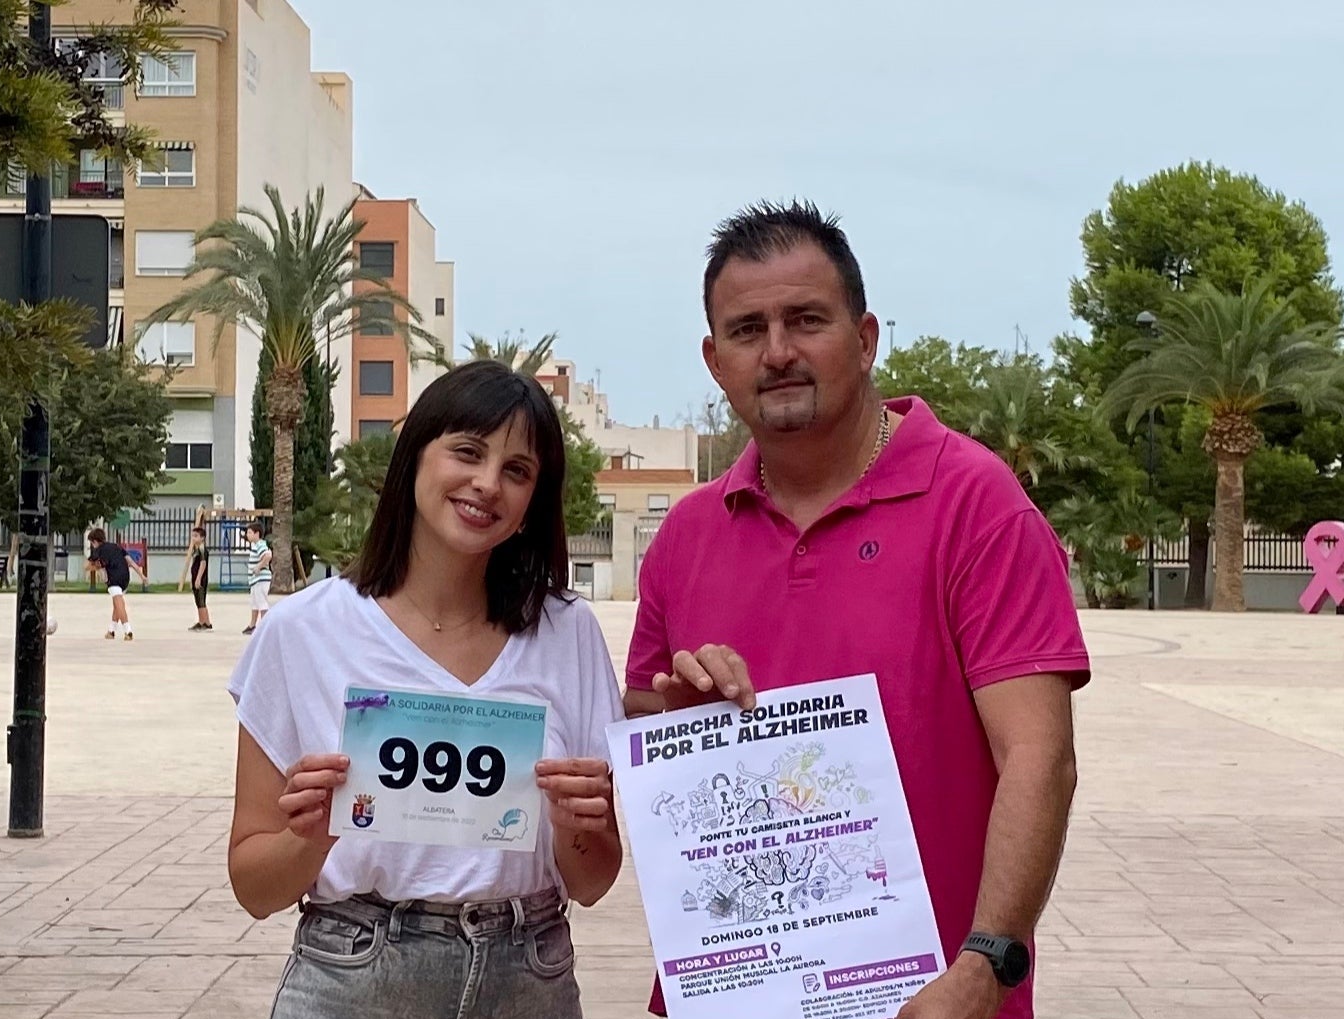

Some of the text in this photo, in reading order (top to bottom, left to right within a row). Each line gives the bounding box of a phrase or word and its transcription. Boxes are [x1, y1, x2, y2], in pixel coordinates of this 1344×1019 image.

[398, 698, 451, 713] SOLIDARIA
[454, 704, 473, 715] POR
[476, 707, 489, 716] EL
[489, 708, 545, 722] ALZHEIMER
[644, 694, 845, 745] MARCHA SOLIDARIA
[646, 708, 869, 763] POR EL ALZHEIMER
[378, 737, 506, 797] 999
[422, 806, 456, 815] ALBATERA
[680, 817, 879, 861] "VEN CON EL ALZHEIMER"
[700, 810, 851, 843] PONTE TU CAMISETA BLANCA Y
[701, 907, 879, 946] DOMINGO 18 DE SEPTIEMBRE
[676, 948, 764, 972] HORA Y LUGAR
[679, 963, 748, 982] CONCENTRACIÓN
[758, 960, 774, 968] LAS
[681, 979, 712, 990] PARQUE
[714, 974, 741, 984] UNIÓN
[743, 969, 778, 979] MUSICAL
[793, 959, 826, 971] AURORA
[829, 961, 920, 985] INSCRIPCIONES
[682, 988, 711, 999] SALIDA
[721, 984, 736, 992] LAS
